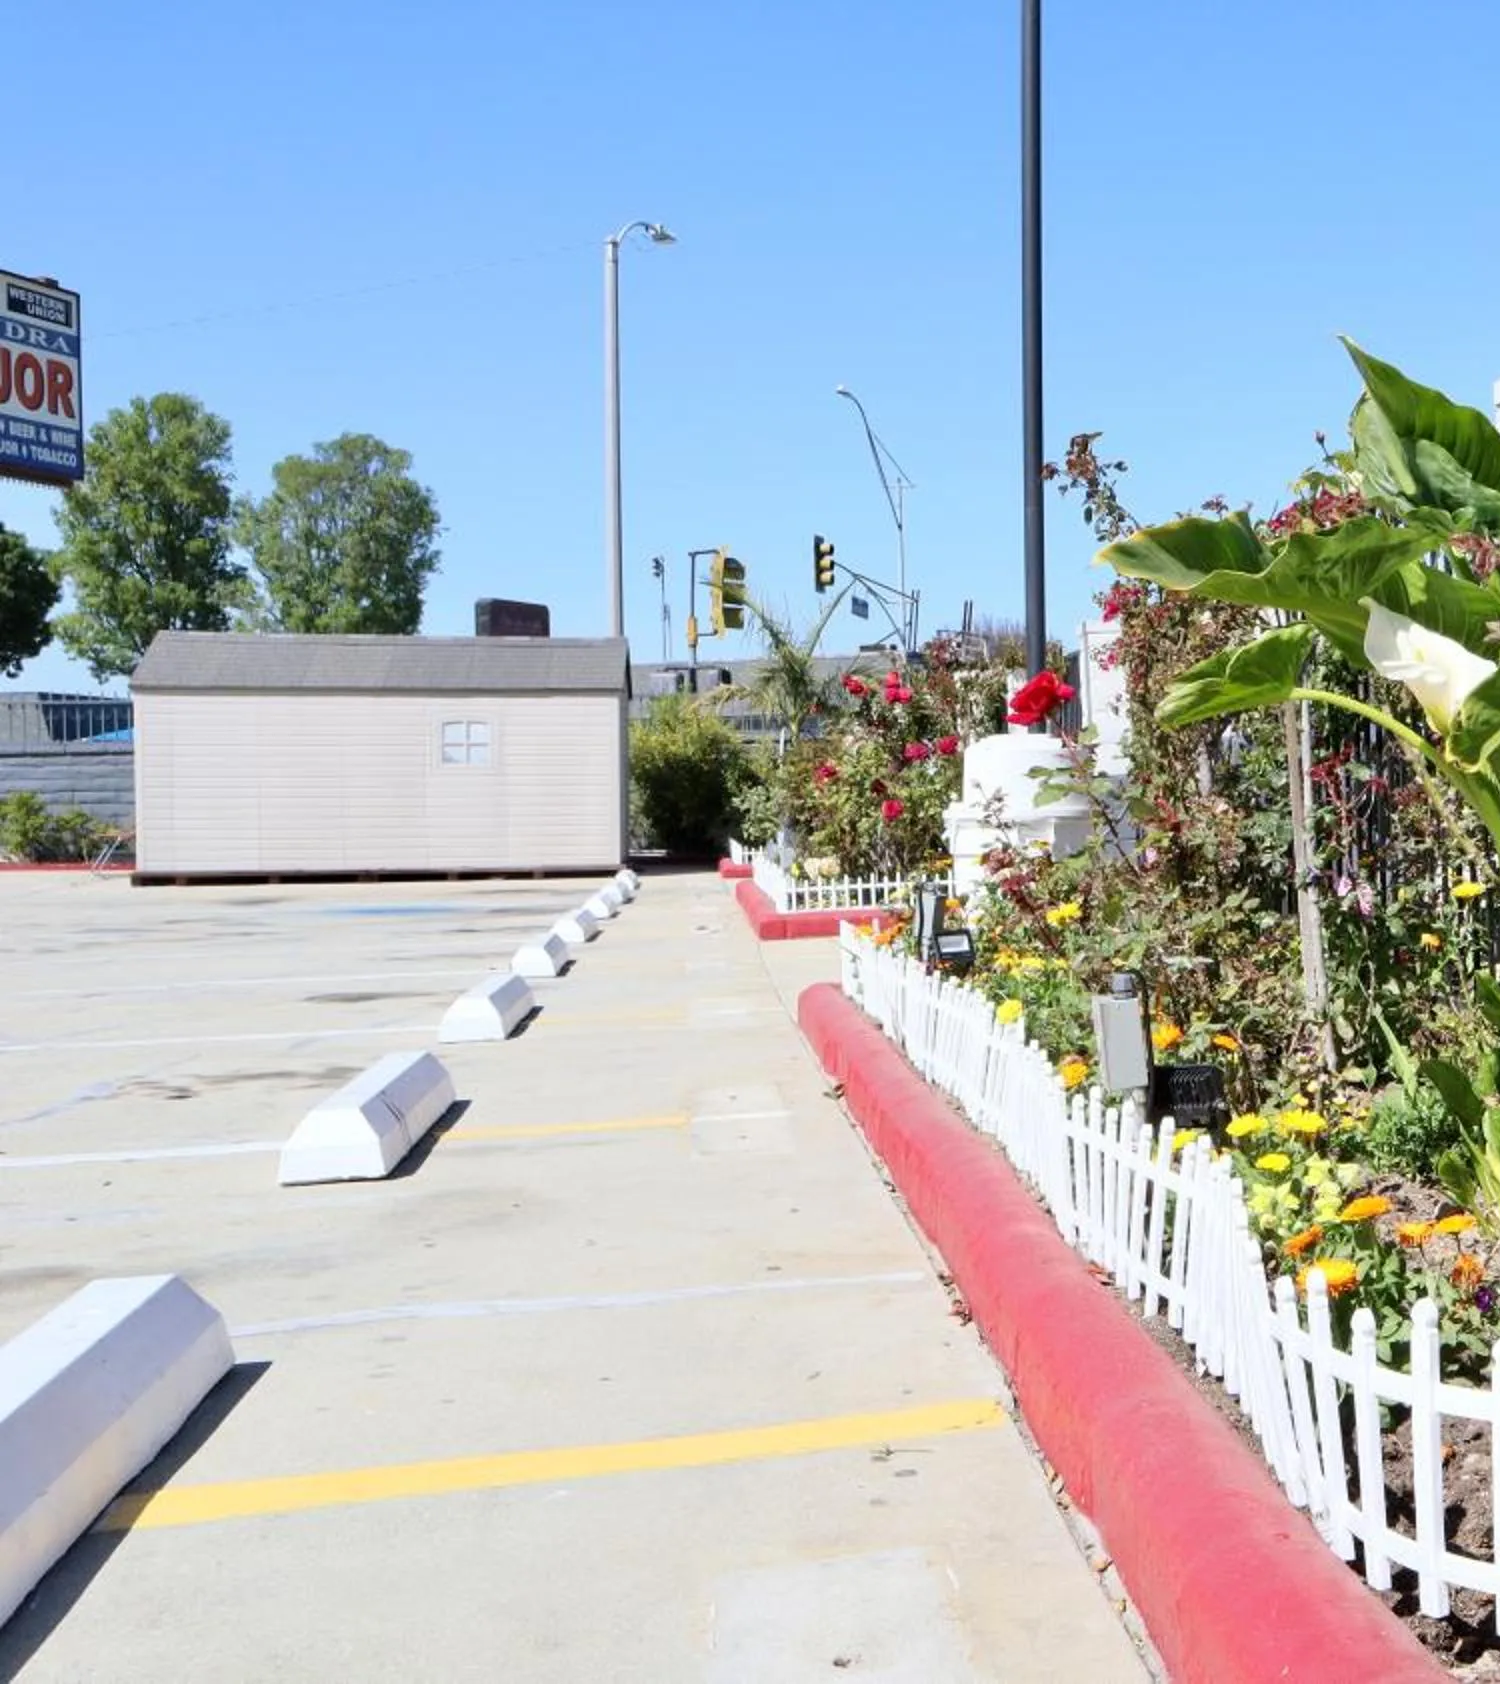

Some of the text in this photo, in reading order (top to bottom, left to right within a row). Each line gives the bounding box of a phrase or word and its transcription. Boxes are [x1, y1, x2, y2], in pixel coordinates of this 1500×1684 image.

[9, 287, 66, 312] WESTERN
[27, 303, 66, 323] UNION
[4, 321, 72, 353] DRA
